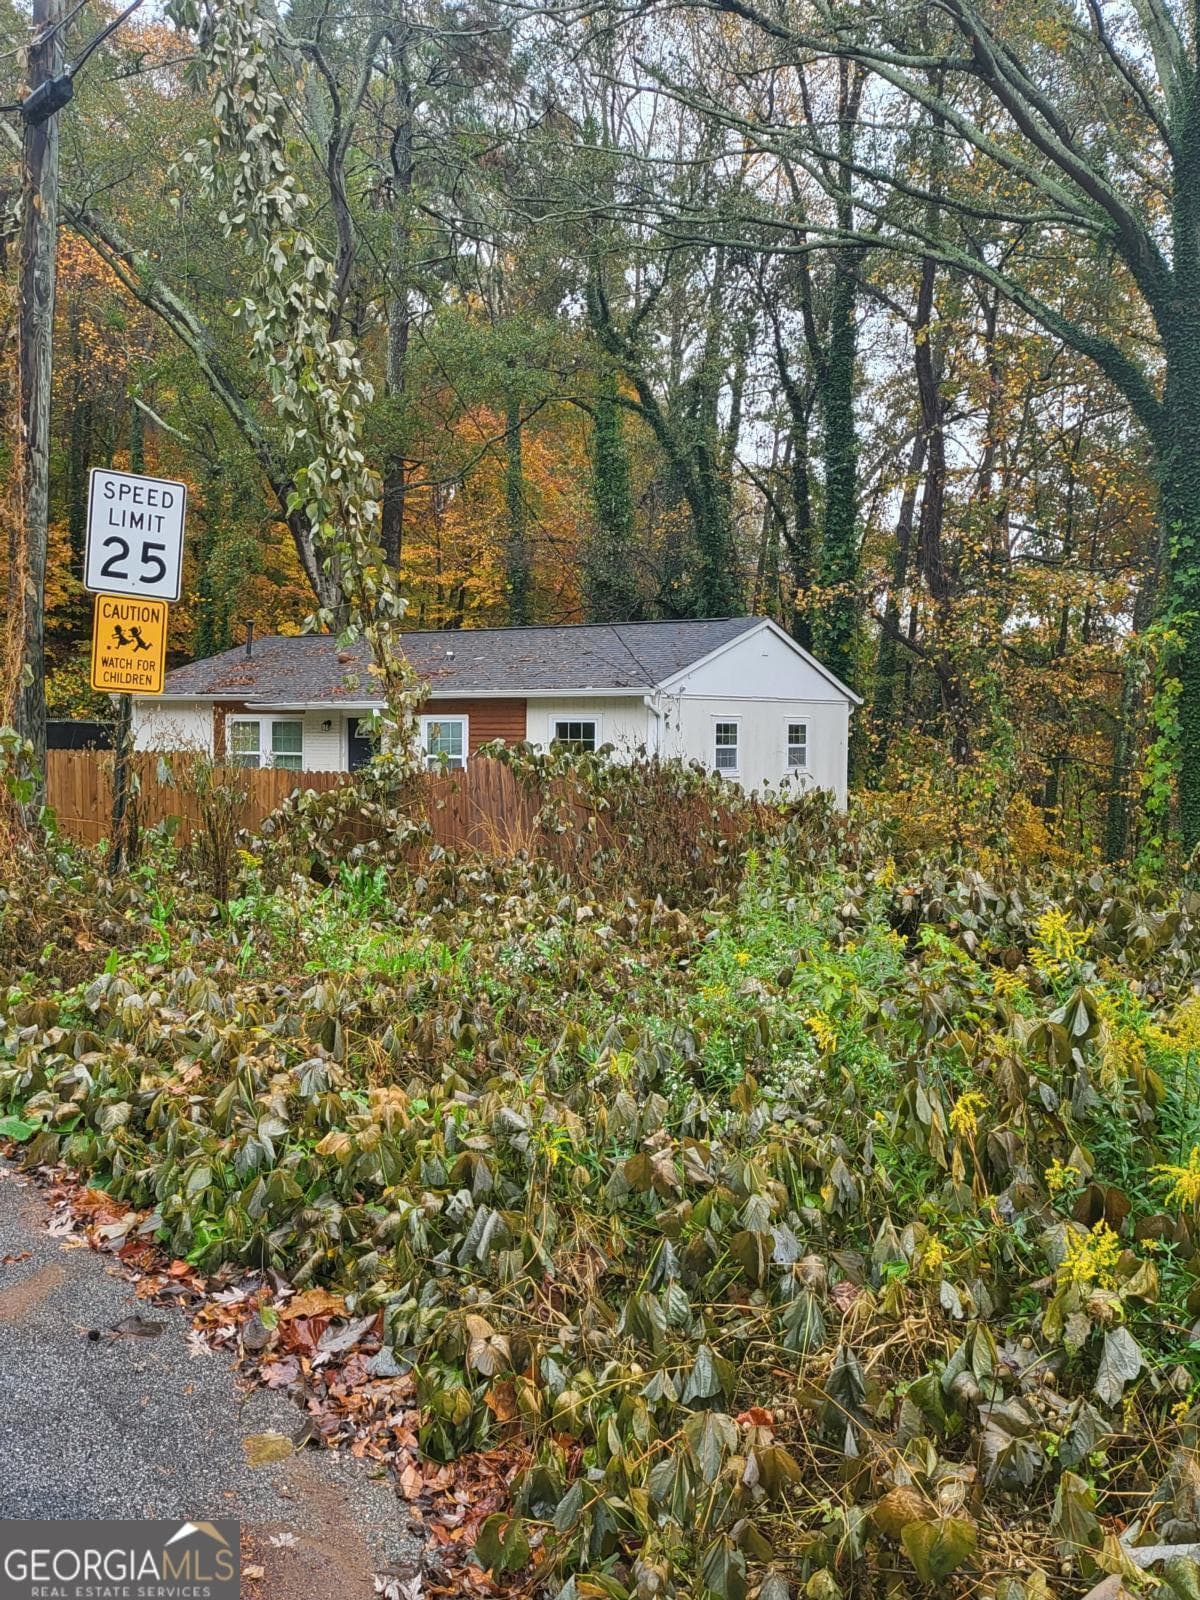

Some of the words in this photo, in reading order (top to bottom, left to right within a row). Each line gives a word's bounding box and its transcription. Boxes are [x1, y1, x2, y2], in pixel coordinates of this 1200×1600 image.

[103, 481, 174, 509] SPEED
[108, 508, 165, 533] LIMIT
[100, 535, 167, 584] 25
[103, 602, 160, 624] CAUTION
[101, 656, 133, 671] WATCH
[137, 659, 156, 672] FOR
[103, 671, 152, 686] CHILDREN
